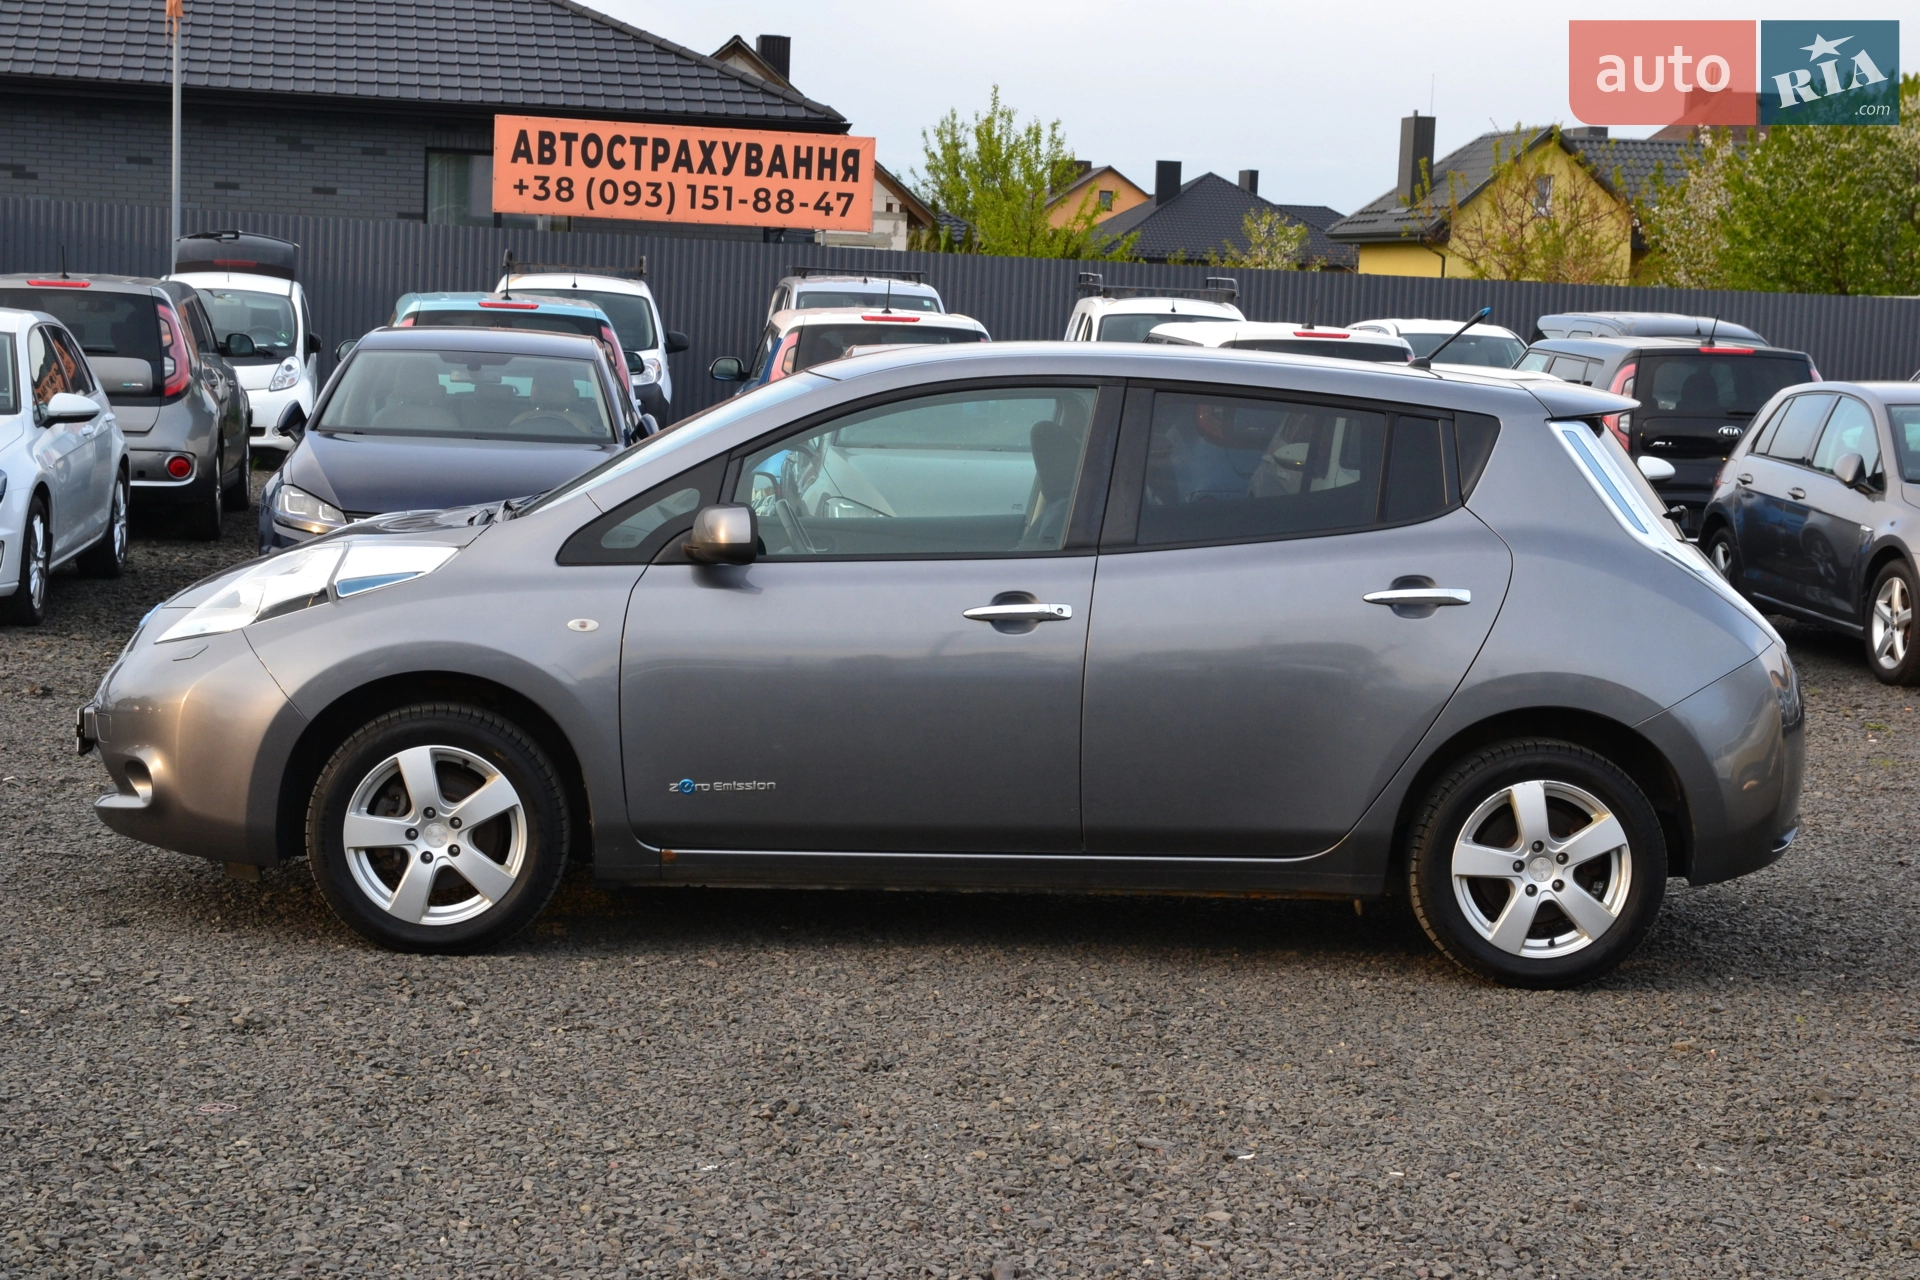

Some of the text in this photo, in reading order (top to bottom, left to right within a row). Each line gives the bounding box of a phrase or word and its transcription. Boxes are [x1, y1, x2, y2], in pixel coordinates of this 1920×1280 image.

[510, 129, 861, 183] АВТОСТРАХУВАННЯ
[513, 175, 855, 217] +38 (093) 151-88-47
